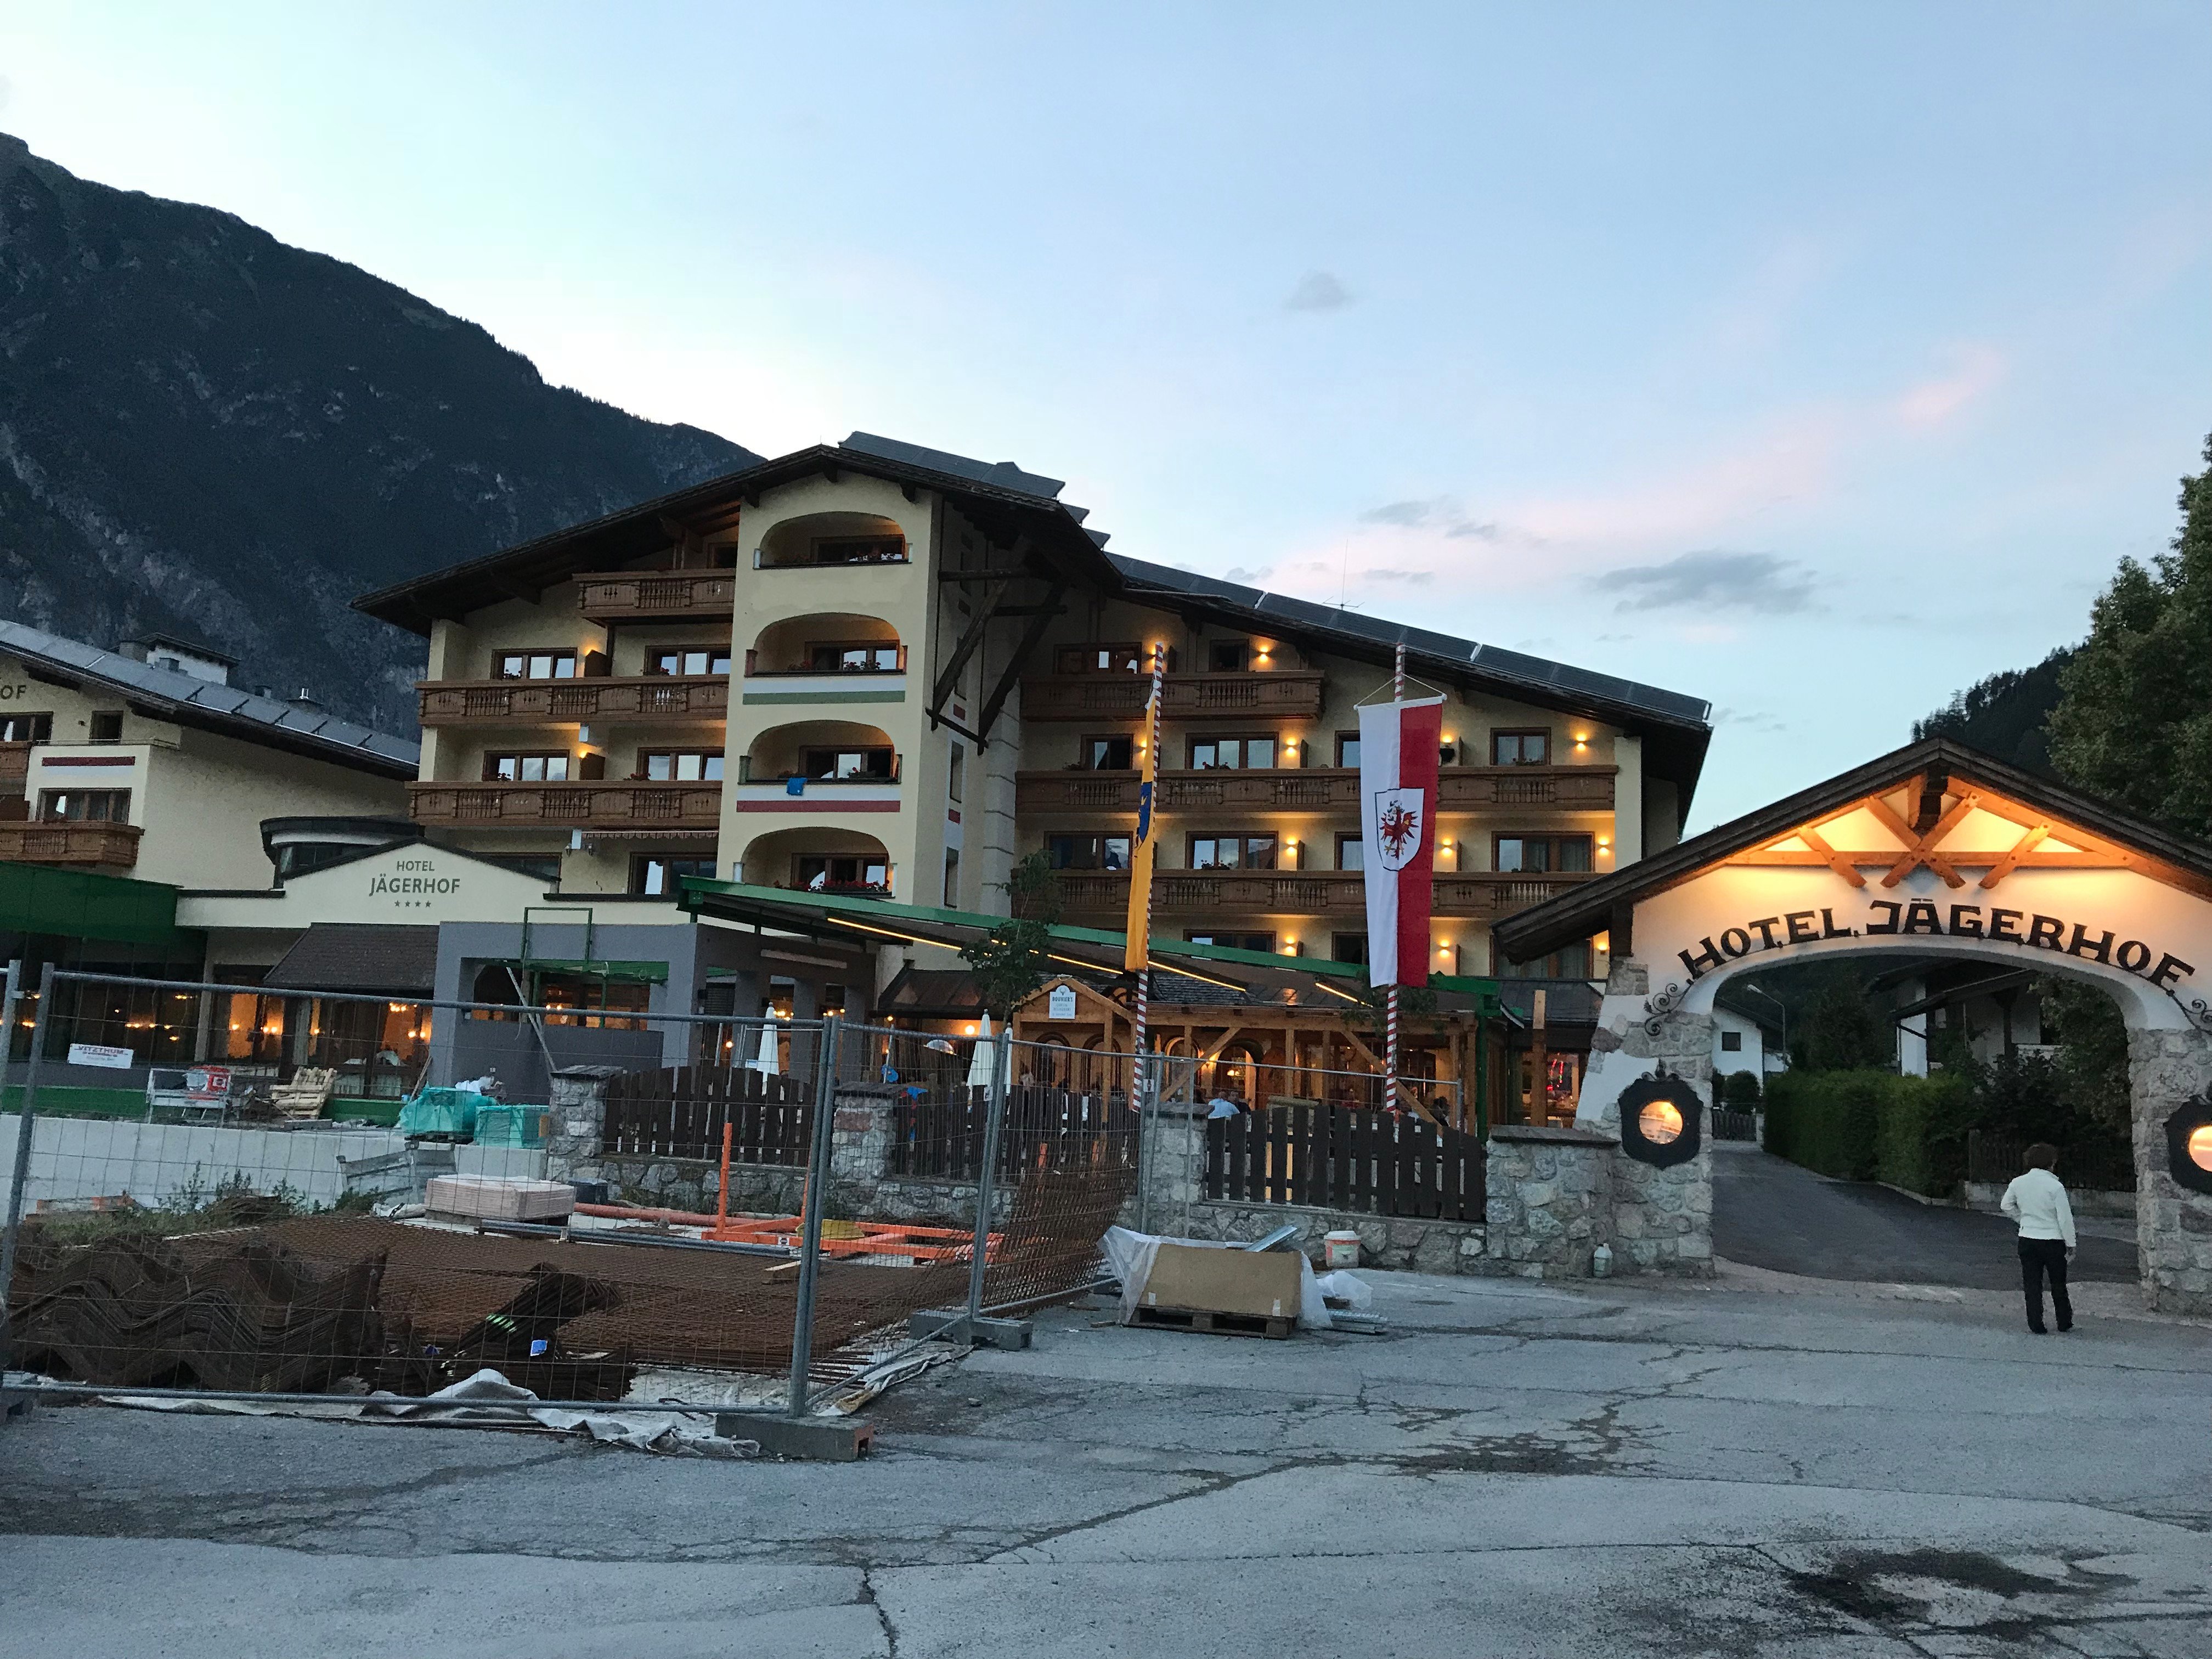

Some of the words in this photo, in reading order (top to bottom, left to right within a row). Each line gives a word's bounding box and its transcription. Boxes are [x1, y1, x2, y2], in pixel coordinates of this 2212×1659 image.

[397, 861, 435, 871] HOTEL
[369, 873, 461, 896] JÄGERHOF
[1677, 908, 1852, 980] HOTEL
[1866, 898, 2196, 986] JÄGERHOF
